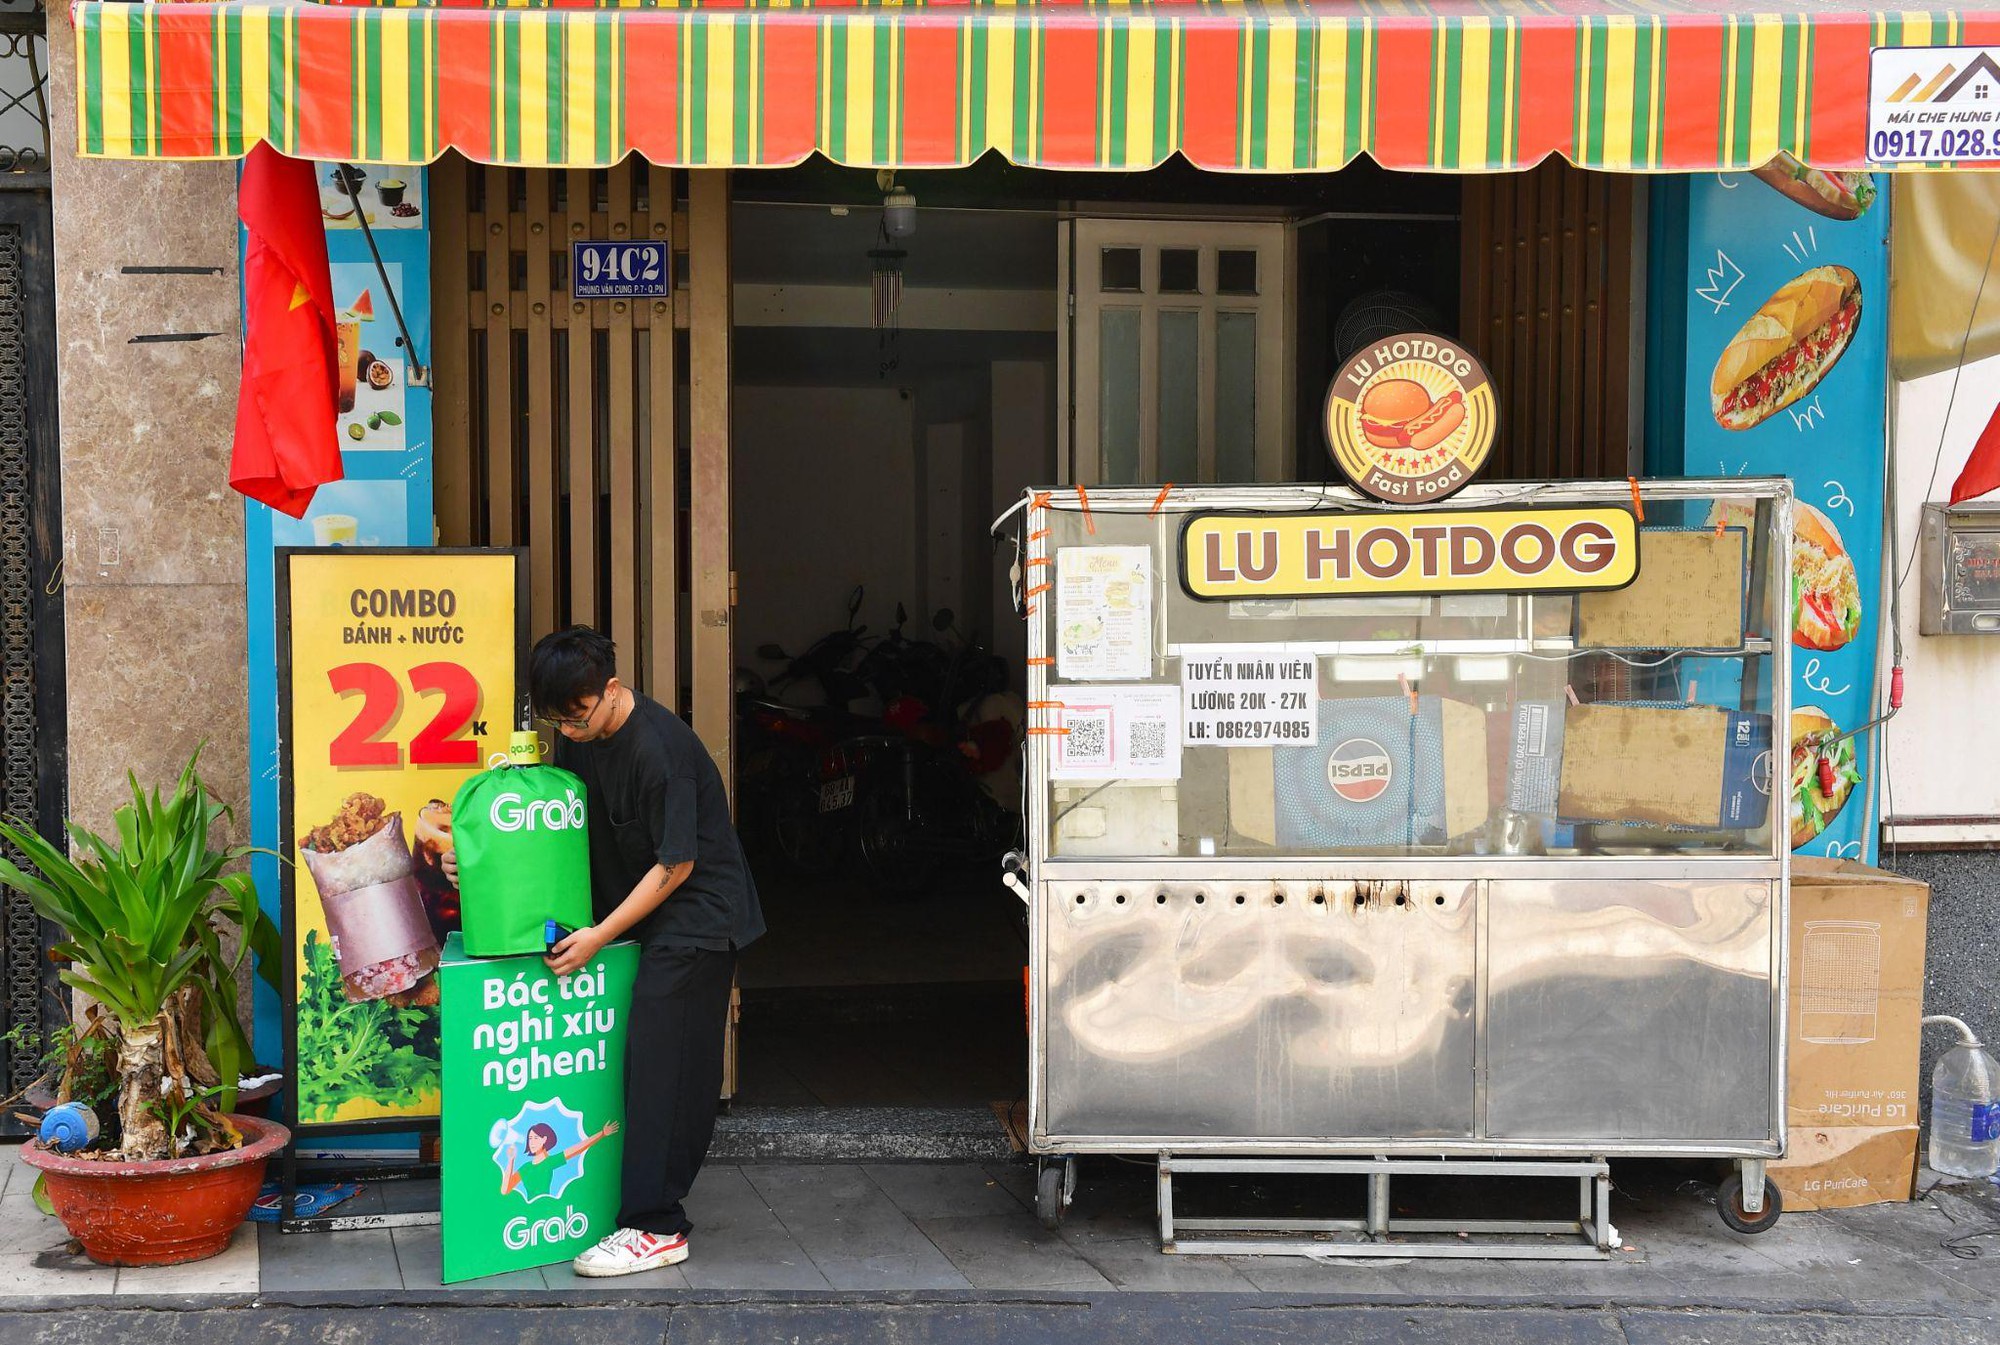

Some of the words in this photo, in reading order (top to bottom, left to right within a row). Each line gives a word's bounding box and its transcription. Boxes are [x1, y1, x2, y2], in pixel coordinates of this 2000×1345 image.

[1887, 110, 1915, 123] MÁI
[1917, 111, 1947, 123] CHE
[1949, 111, 1992, 123] HƯNG
[582, 247, 659, 281] 94C2
[579, 283, 600, 294] PHÙNG
[601, 283, 613, 293] VĂN
[614, 285, 632, 294] CUNG
[1347, 359, 1373, 387] LU
[1374, 340, 1472, 377] HOTDOG
[1369, 471, 1409, 496] Fast
[1415, 465, 1463, 496] Food
[1204, 531, 1279, 582] LU
[1305, 521, 1617, 581] HOTDOG
[350, 588, 457, 618] COMBO
[343, 621, 392, 644] BÁNH
[412, 621, 464, 644] NƯỚC
[1187, 656, 1233, 680] TUYỂN
[1237, 659, 1274, 680] NHÂN
[1280, 659, 1312, 680] VIÊN
[1191, 690, 1235, 710] LƯƠNG
[1240, 692, 1266, 710] 20K
[1280, 692, 1307, 710] 27K
[1188, 721, 1210, 739] LH:
[1216, 721, 1310, 739] 0862974985
[1738, 720, 1750, 735] 12
[510, 744, 535, 755] Grab
[1331, 763, 1388, 778] PEPSI
[490, 788, 585, 832] Grab
[483, 972, 549, 1011] Bác
[557, 963, 606, 1000] tài
[473, 1004, 554, 1055] nghỉ
[562, 1001, 615, 1038] xíu
[482, 1040, 606, 1092] nghen!
[1839, 1090, 1870, 1099] Purifier
[1871, 1090, 1884, 1099] Air
[1818, 1103, 1881, 1117] PuriCare
[1886, 1103, 1907, 1117] LG
[1803, 1180, 1821, 1191] LG
[1824, 1177, 1868, 1190] PuriCare
[503, 1204, 589, 1250] Grab
